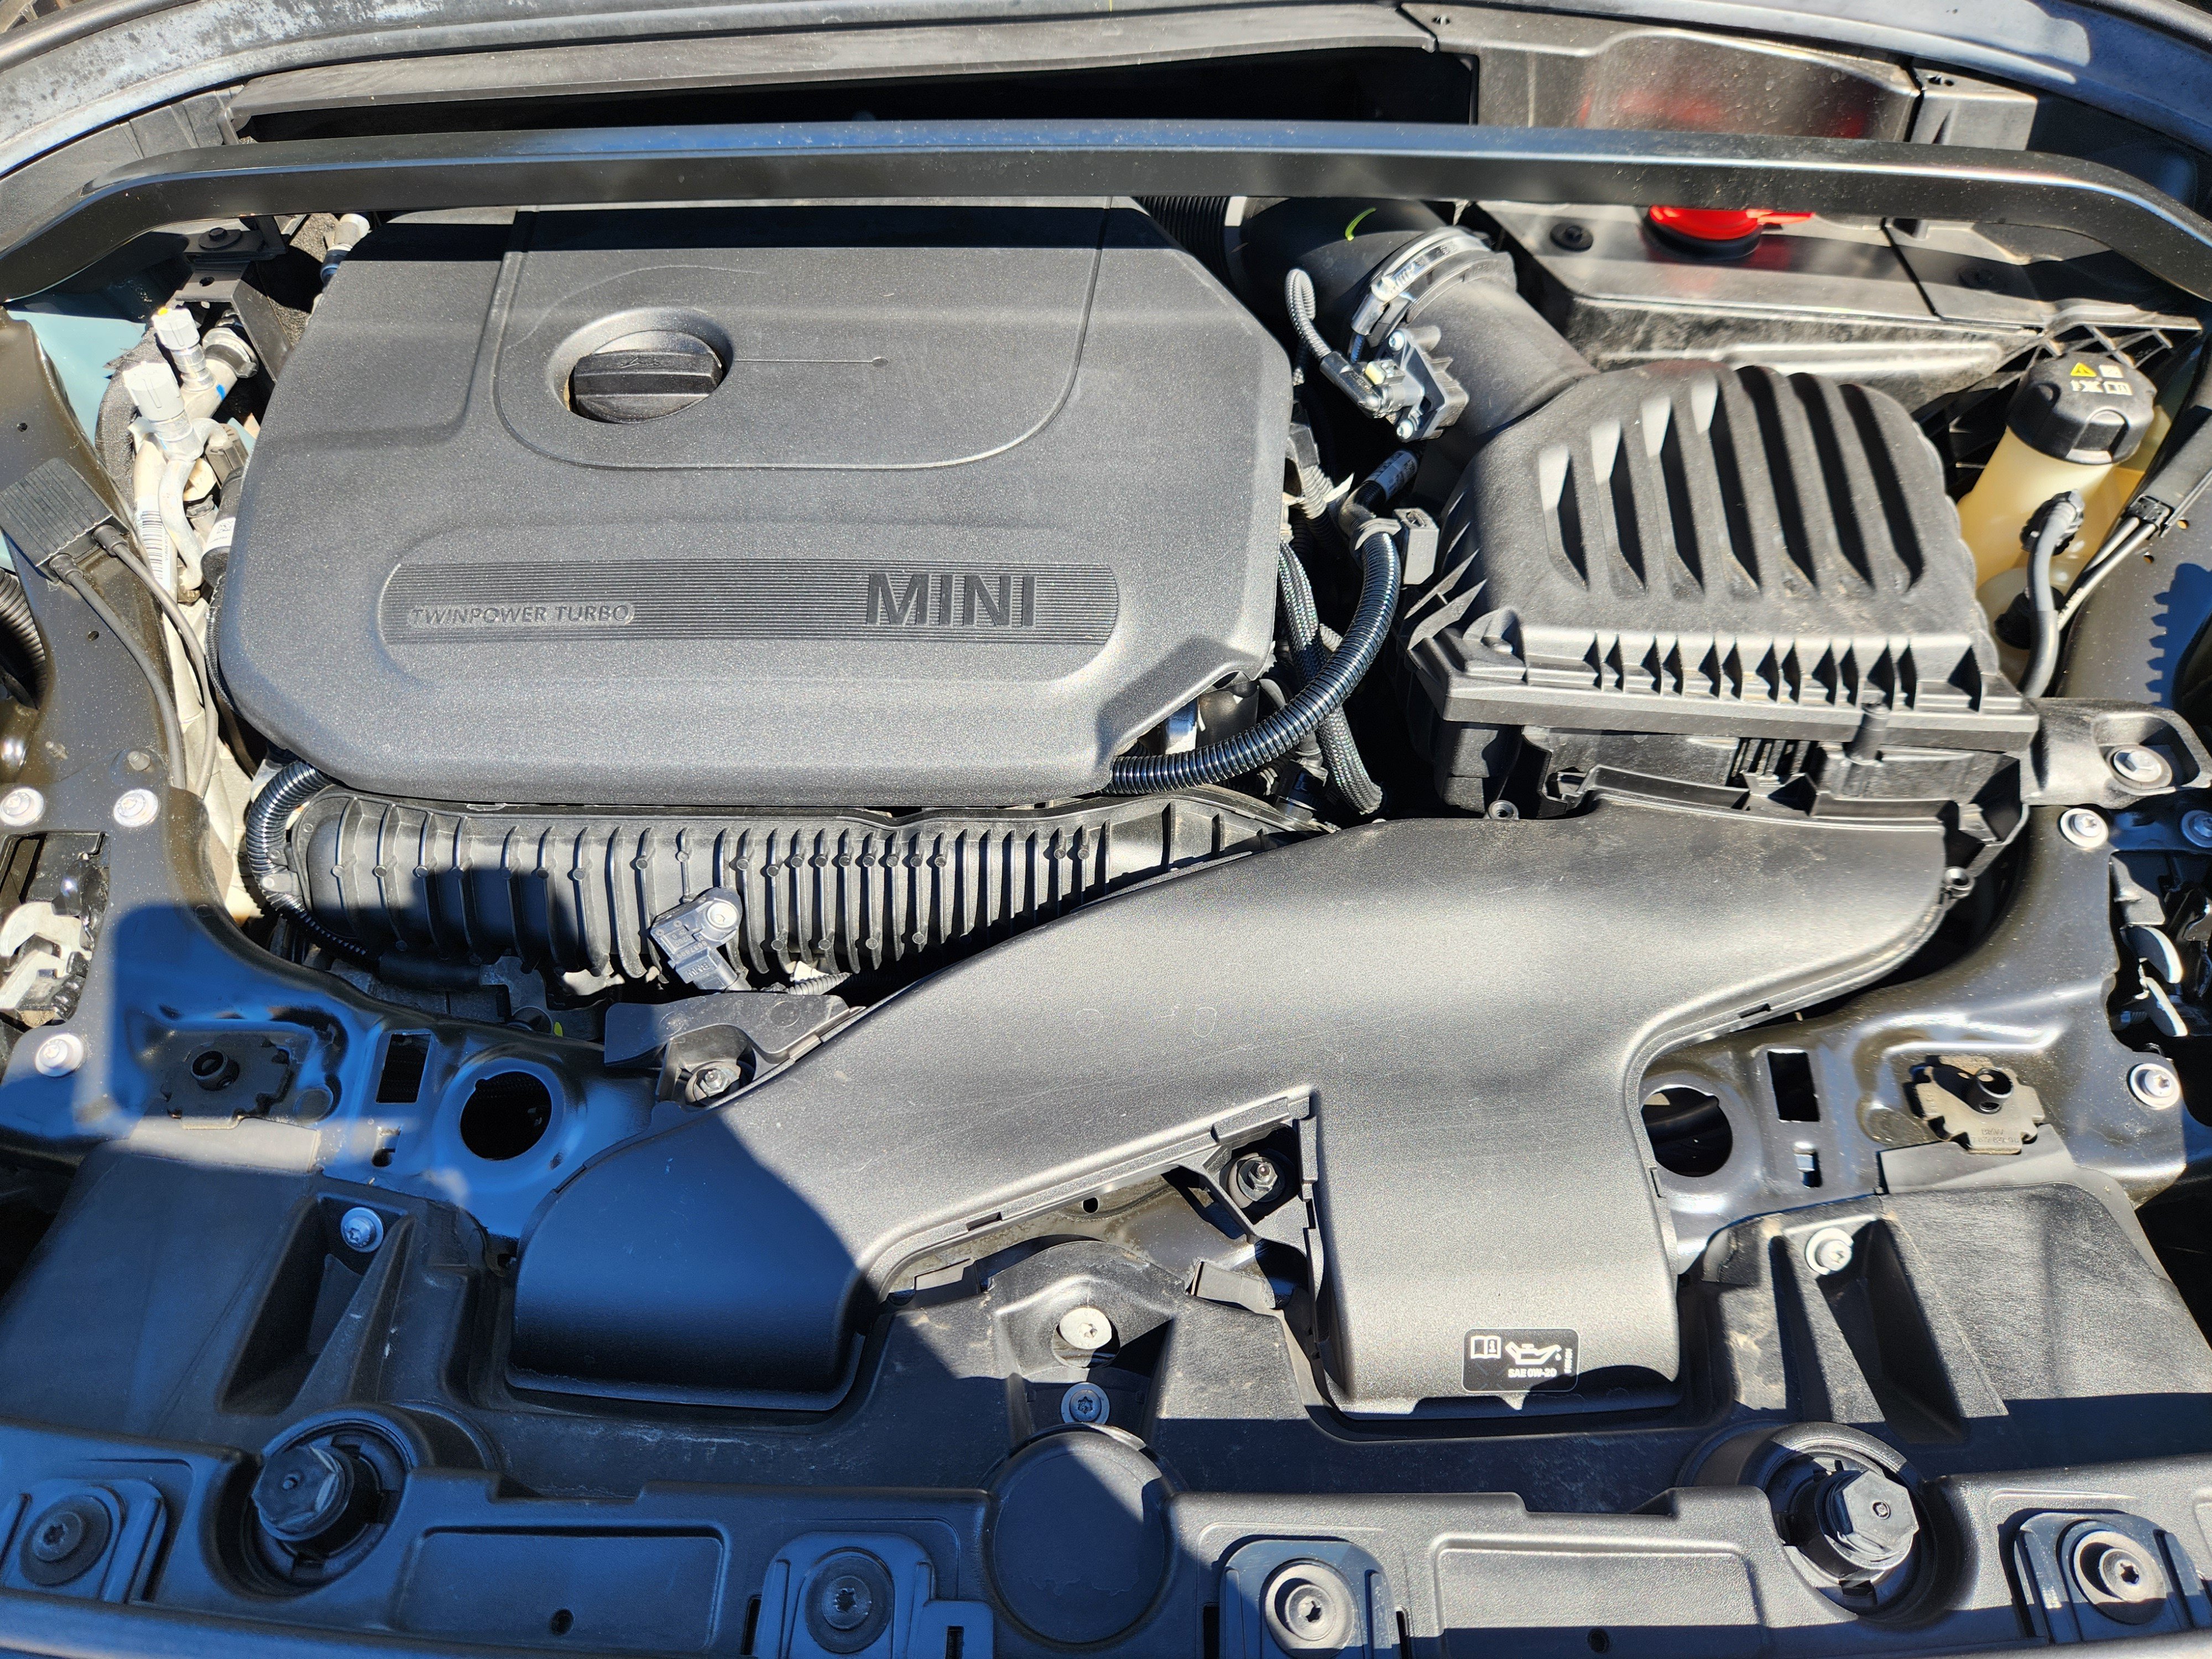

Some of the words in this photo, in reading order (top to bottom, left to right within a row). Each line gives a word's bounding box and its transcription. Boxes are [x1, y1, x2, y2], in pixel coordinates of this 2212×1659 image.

[866, 573, 1036, 627] MINI
[413, 606, 547, 624] TWINPOWER
[555, 605, 629, 622] TURBO
[687, 962, 710, 978] BMW
[1507, 1368, 1527, 1378] SAE
